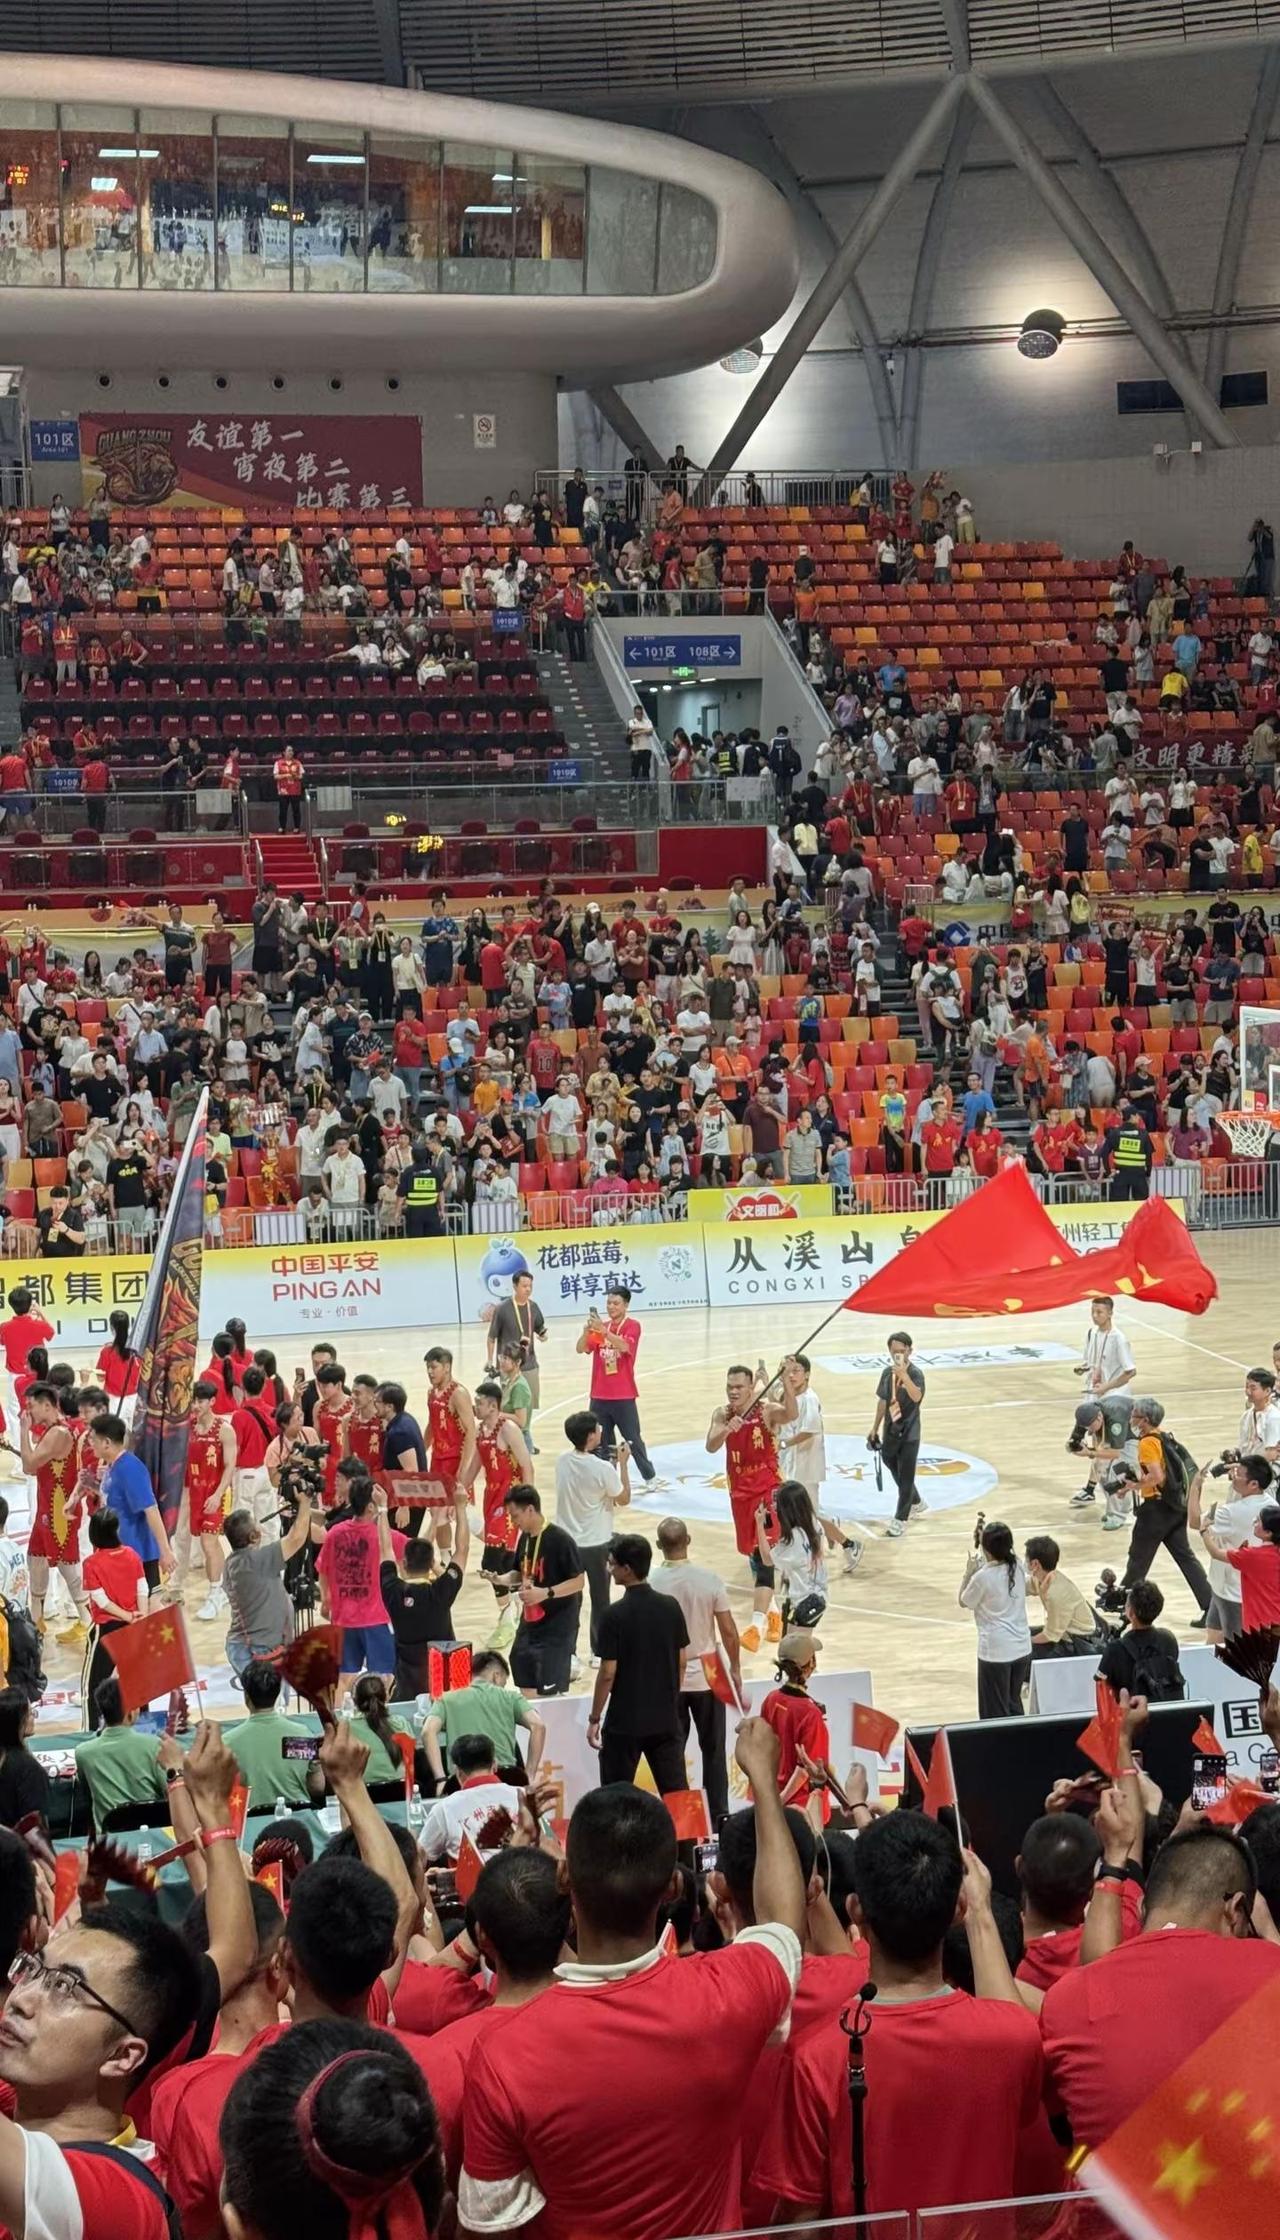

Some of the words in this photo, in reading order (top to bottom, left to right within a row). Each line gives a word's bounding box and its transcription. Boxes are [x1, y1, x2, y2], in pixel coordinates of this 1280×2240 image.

[34, 433, 74, 447] 101区
[186, 419, 304, 451] 友谊第一
[233, 451, 350, 483] 宵夜第二
[296, 482, 412, 509] 比赛第三
[644, 645, 676, 657] 101区
[689, 645, 720, 657] 108区
[1057, 1222, 1130, 1242] 州轻工
[271, 1251, 379, 1277] 中国平安
[0, 1270, 149, 1309] 都集团
[560, 1270, 647, 1302] 鲜享直达
[728, 1276, 825, 1294] CONGXI
